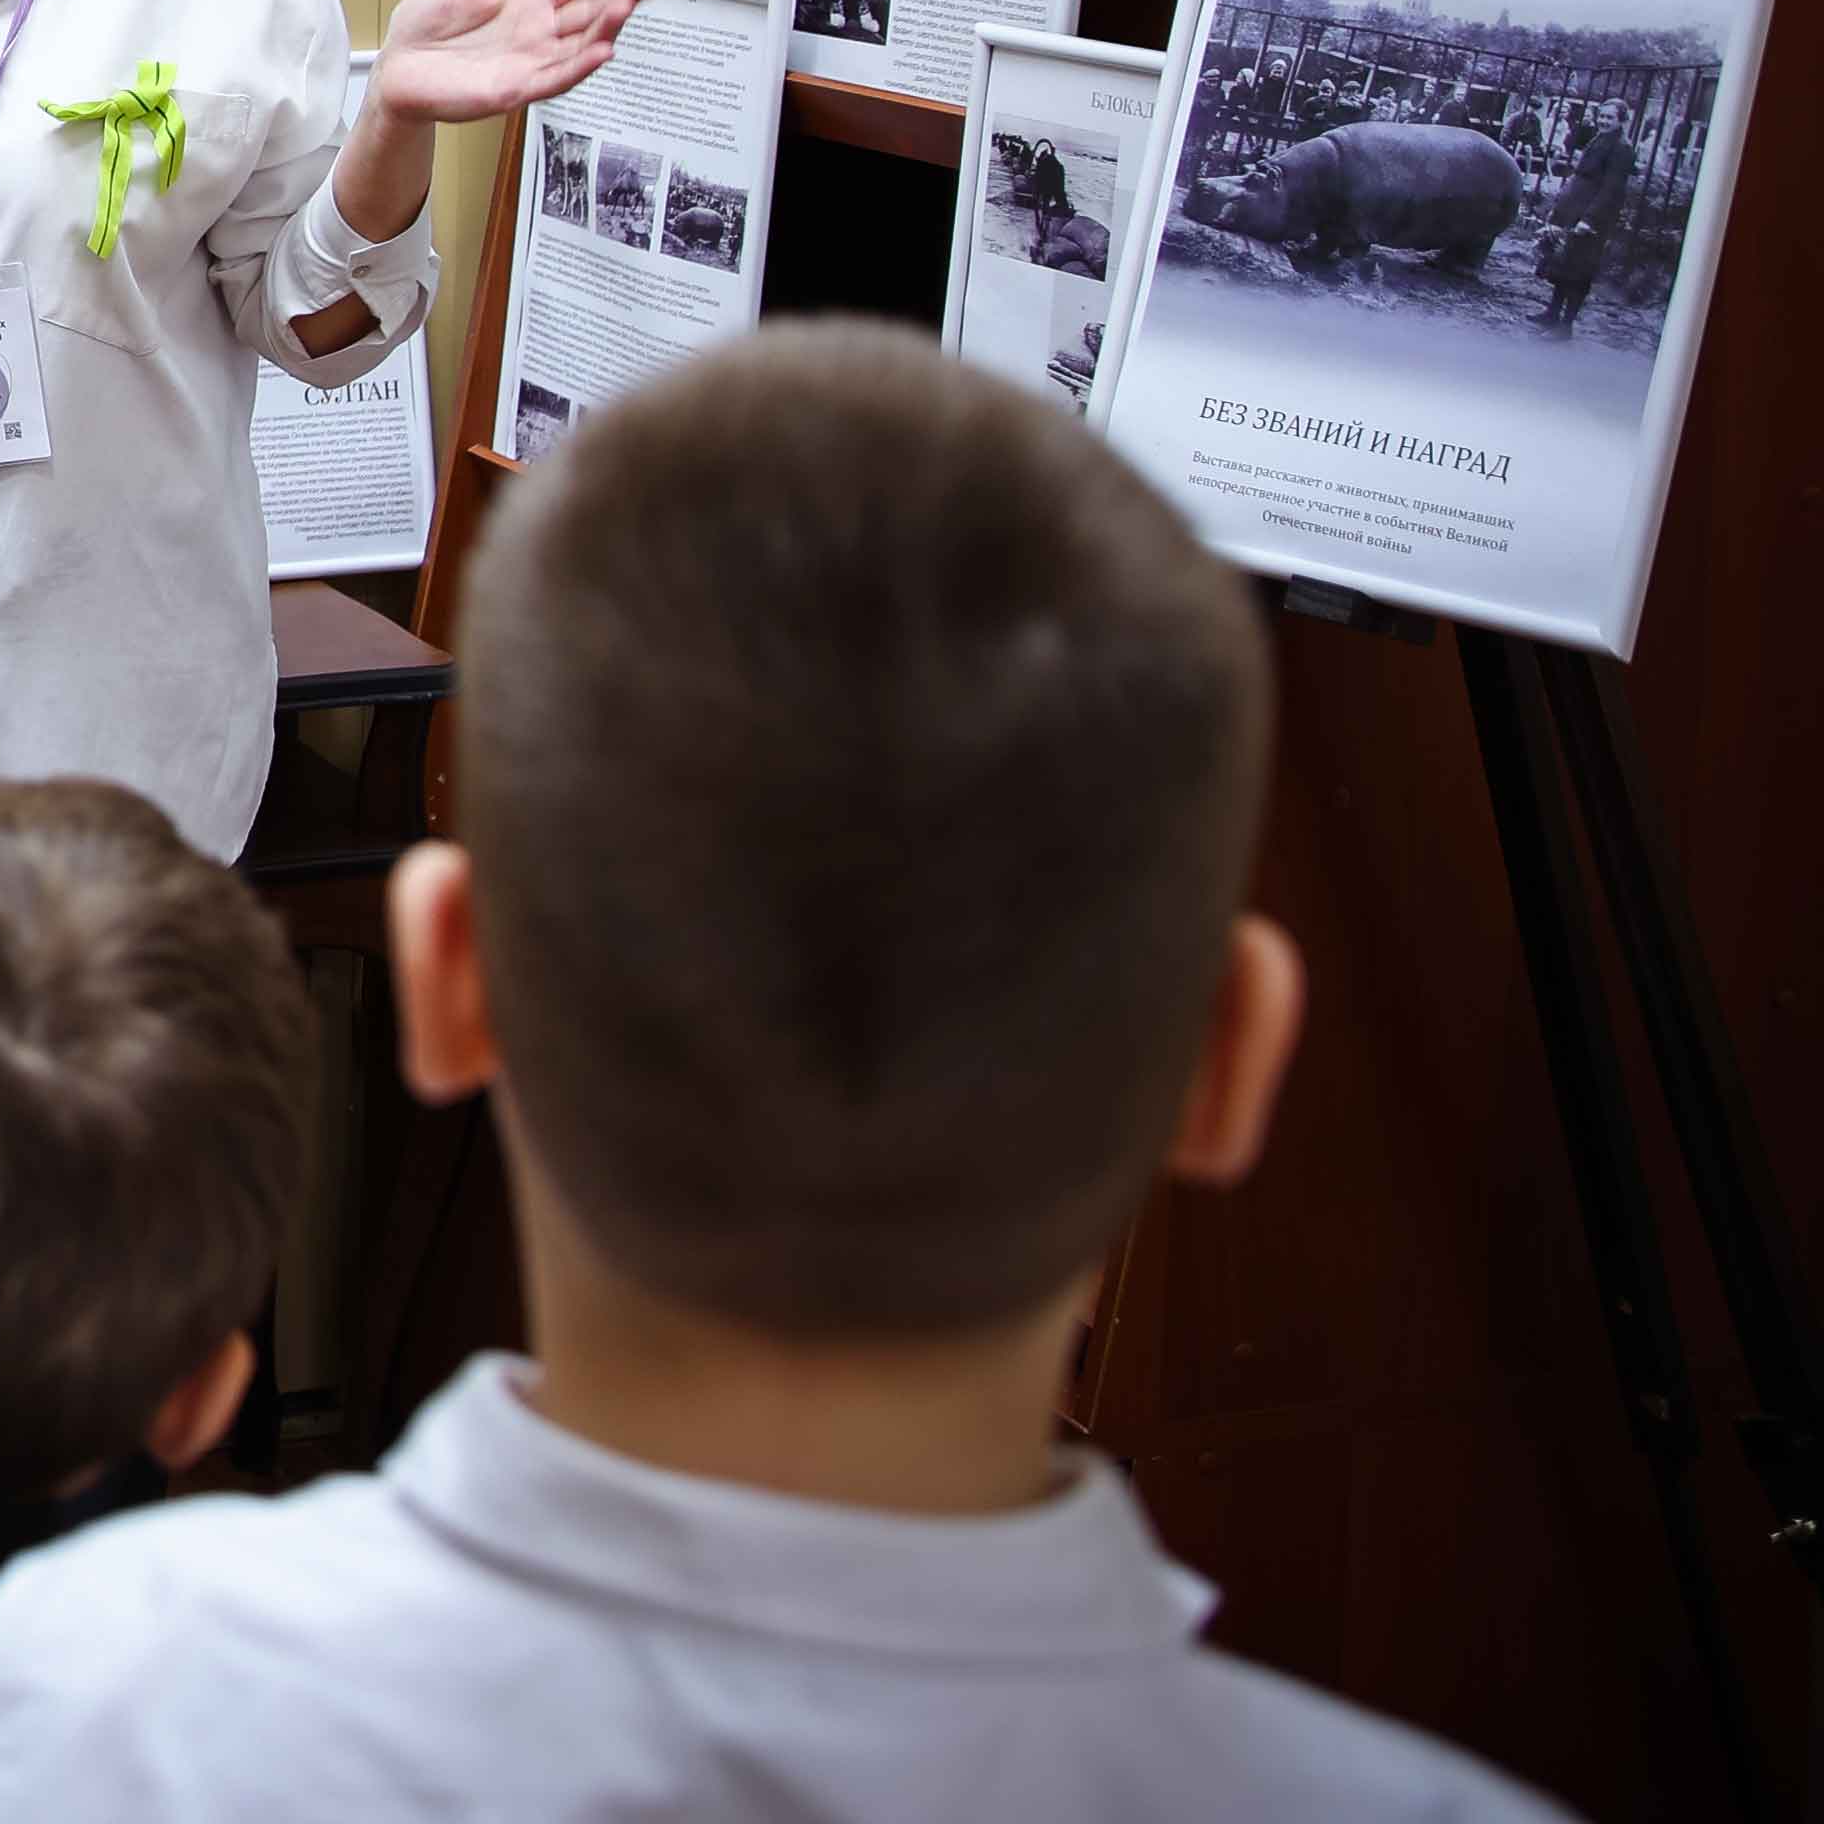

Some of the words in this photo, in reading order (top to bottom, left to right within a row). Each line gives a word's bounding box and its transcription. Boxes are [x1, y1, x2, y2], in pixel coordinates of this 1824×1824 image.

[1199, 397, 1248, 426] БЕЗ
[1251, 407, 1366, 450] ЗВАНИЙ
[1368, 431, 1392, 455] И
[1396, 435, 1513, 484] НАГРАД
[1187, 472, 1305, 508] непосредственное
[1305, 499, 1360, 520] участие
[1363, 511, 1372, 522] в
[1375, 514, 1444, 539] событиях
[1445, 527, 1509, 553] Великой
[1192, 450, 1253, 475] Выставка
[1253, 464, 1322, 490] расскажет
[1324, 480, 1332, 491] о
[1335, 482, 1409, 509] животных,
[1411, 498, 1516, 531] принимавших
[1262, 510, 1364, 544] Отечественной
[1366, 533, 1413, 555] войны
